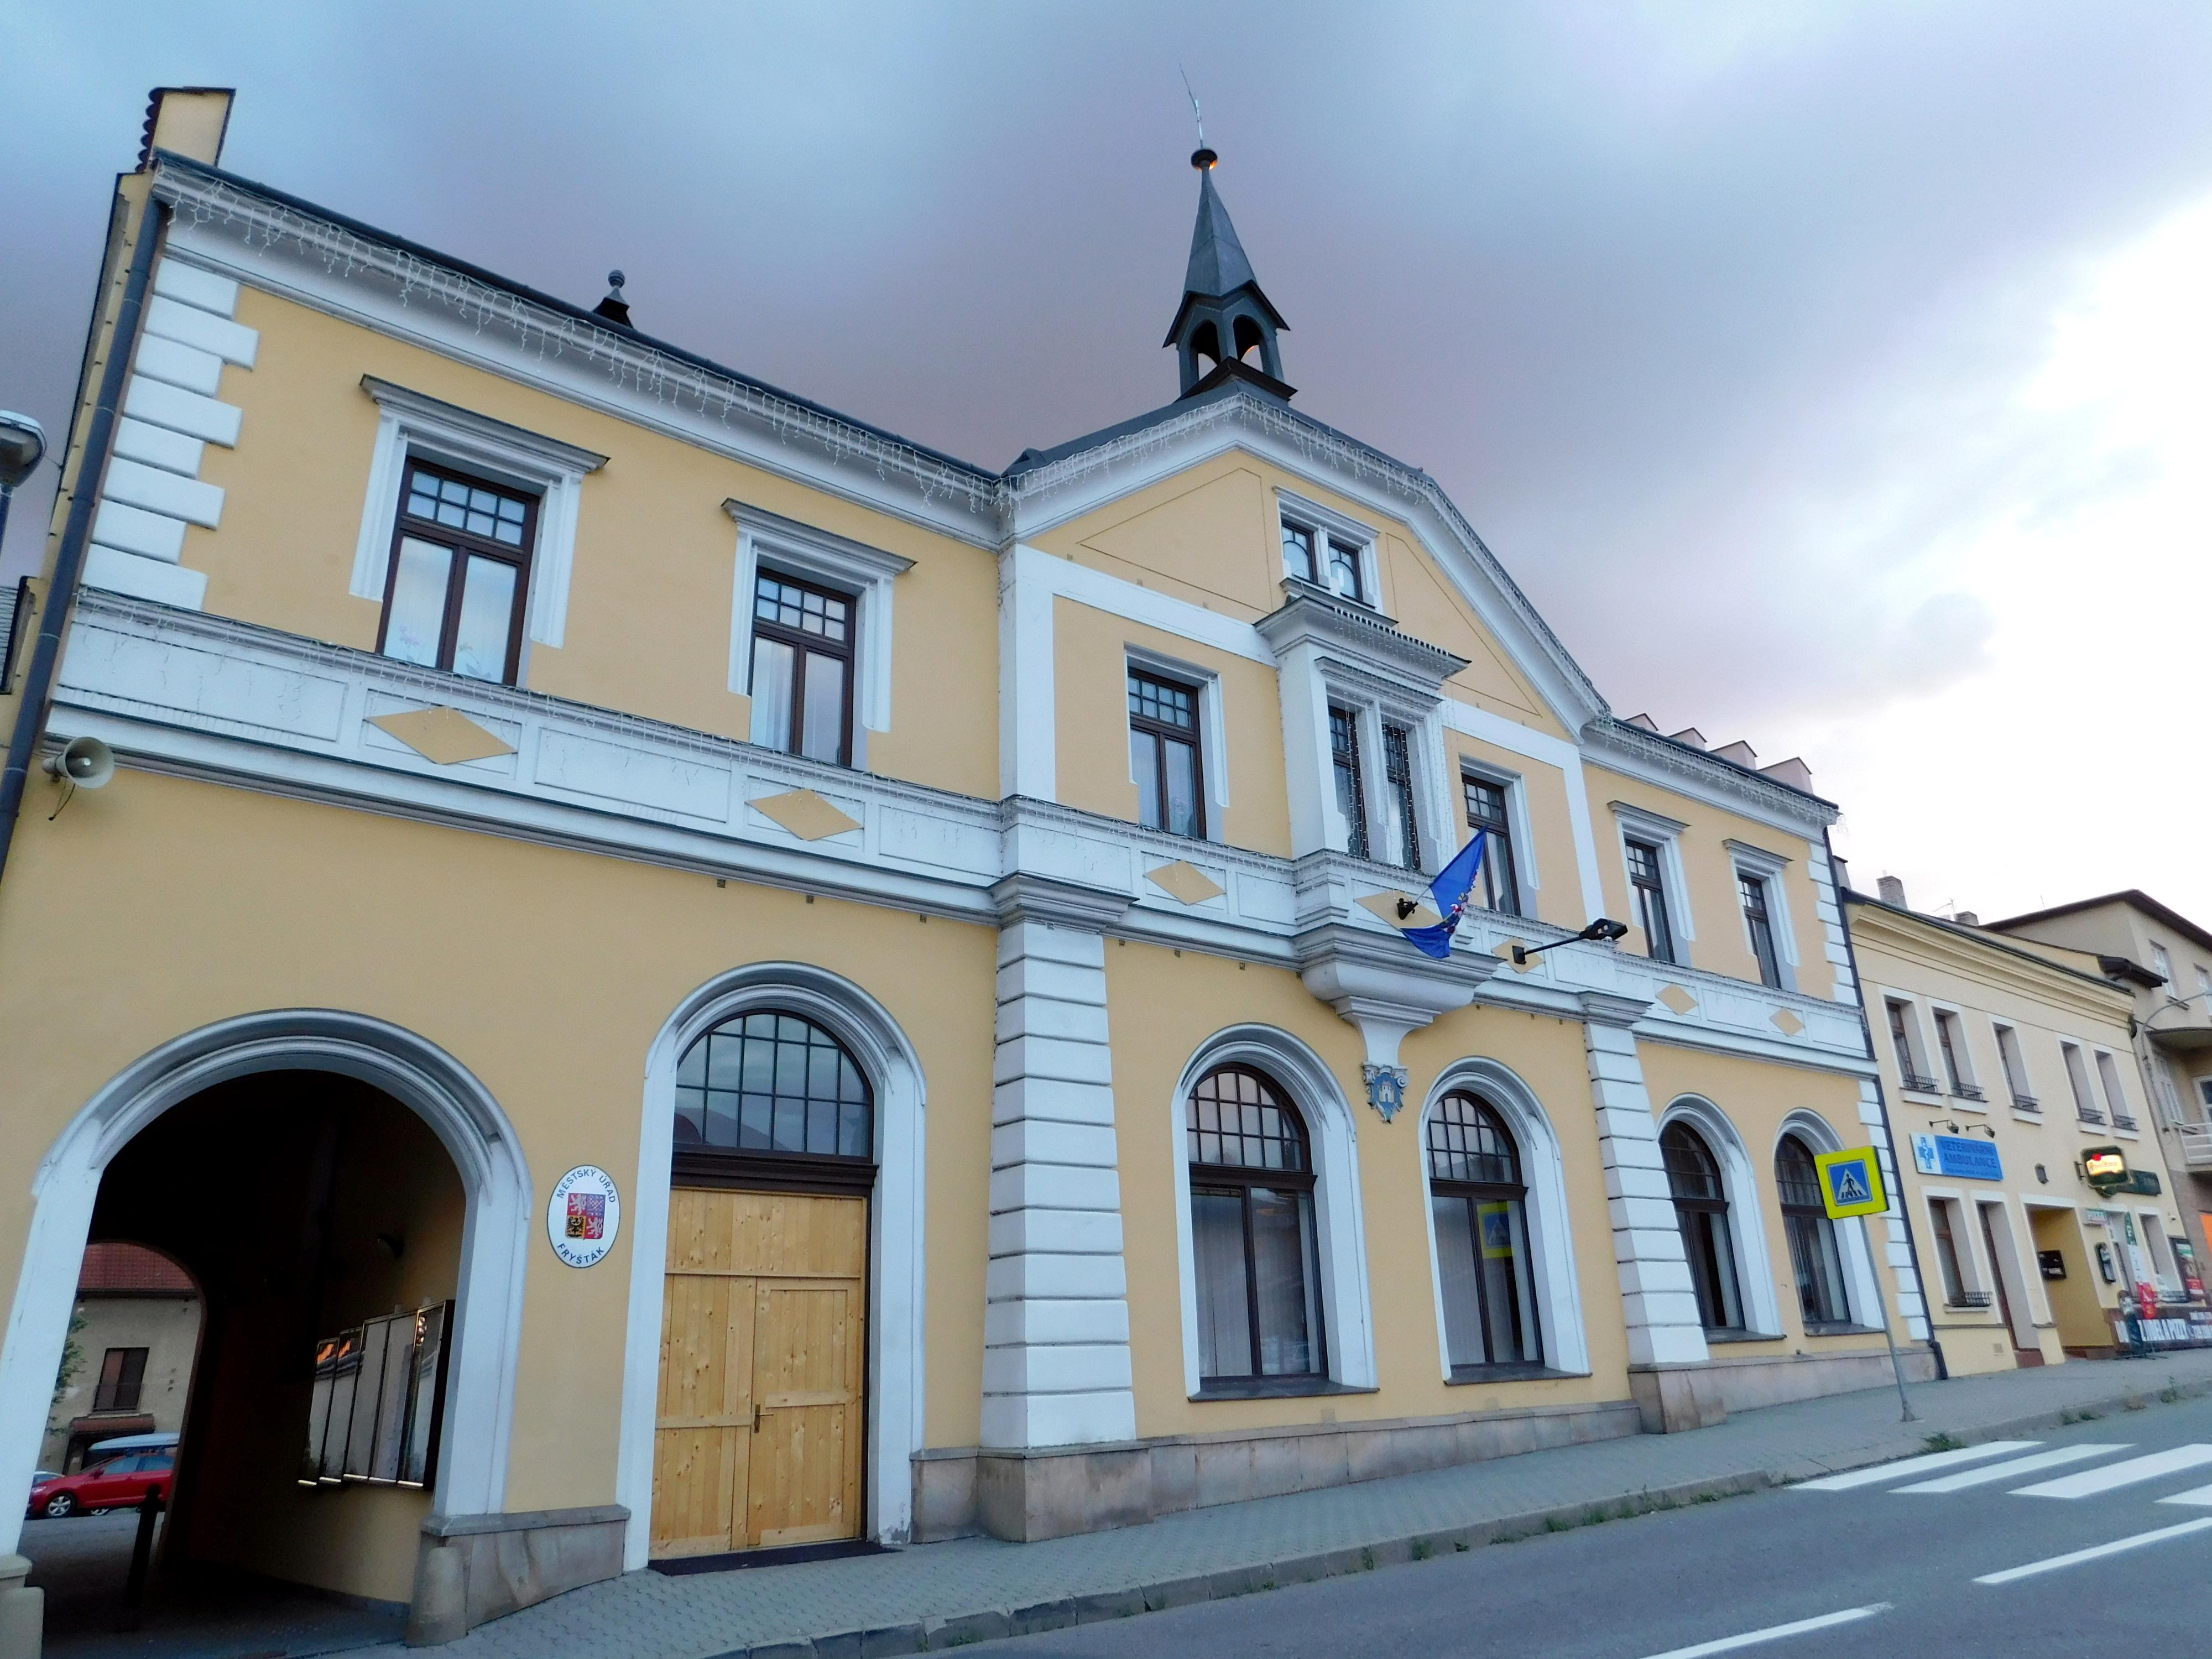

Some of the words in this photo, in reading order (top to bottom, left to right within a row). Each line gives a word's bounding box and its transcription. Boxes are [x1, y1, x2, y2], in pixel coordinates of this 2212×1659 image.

[557, 1168, 597, 1198] MĚSTSKÝ
[599, 1175, 615, 1203] ÚŘAD
[557, 1243, 604, 1264] FRYŠTÁK
